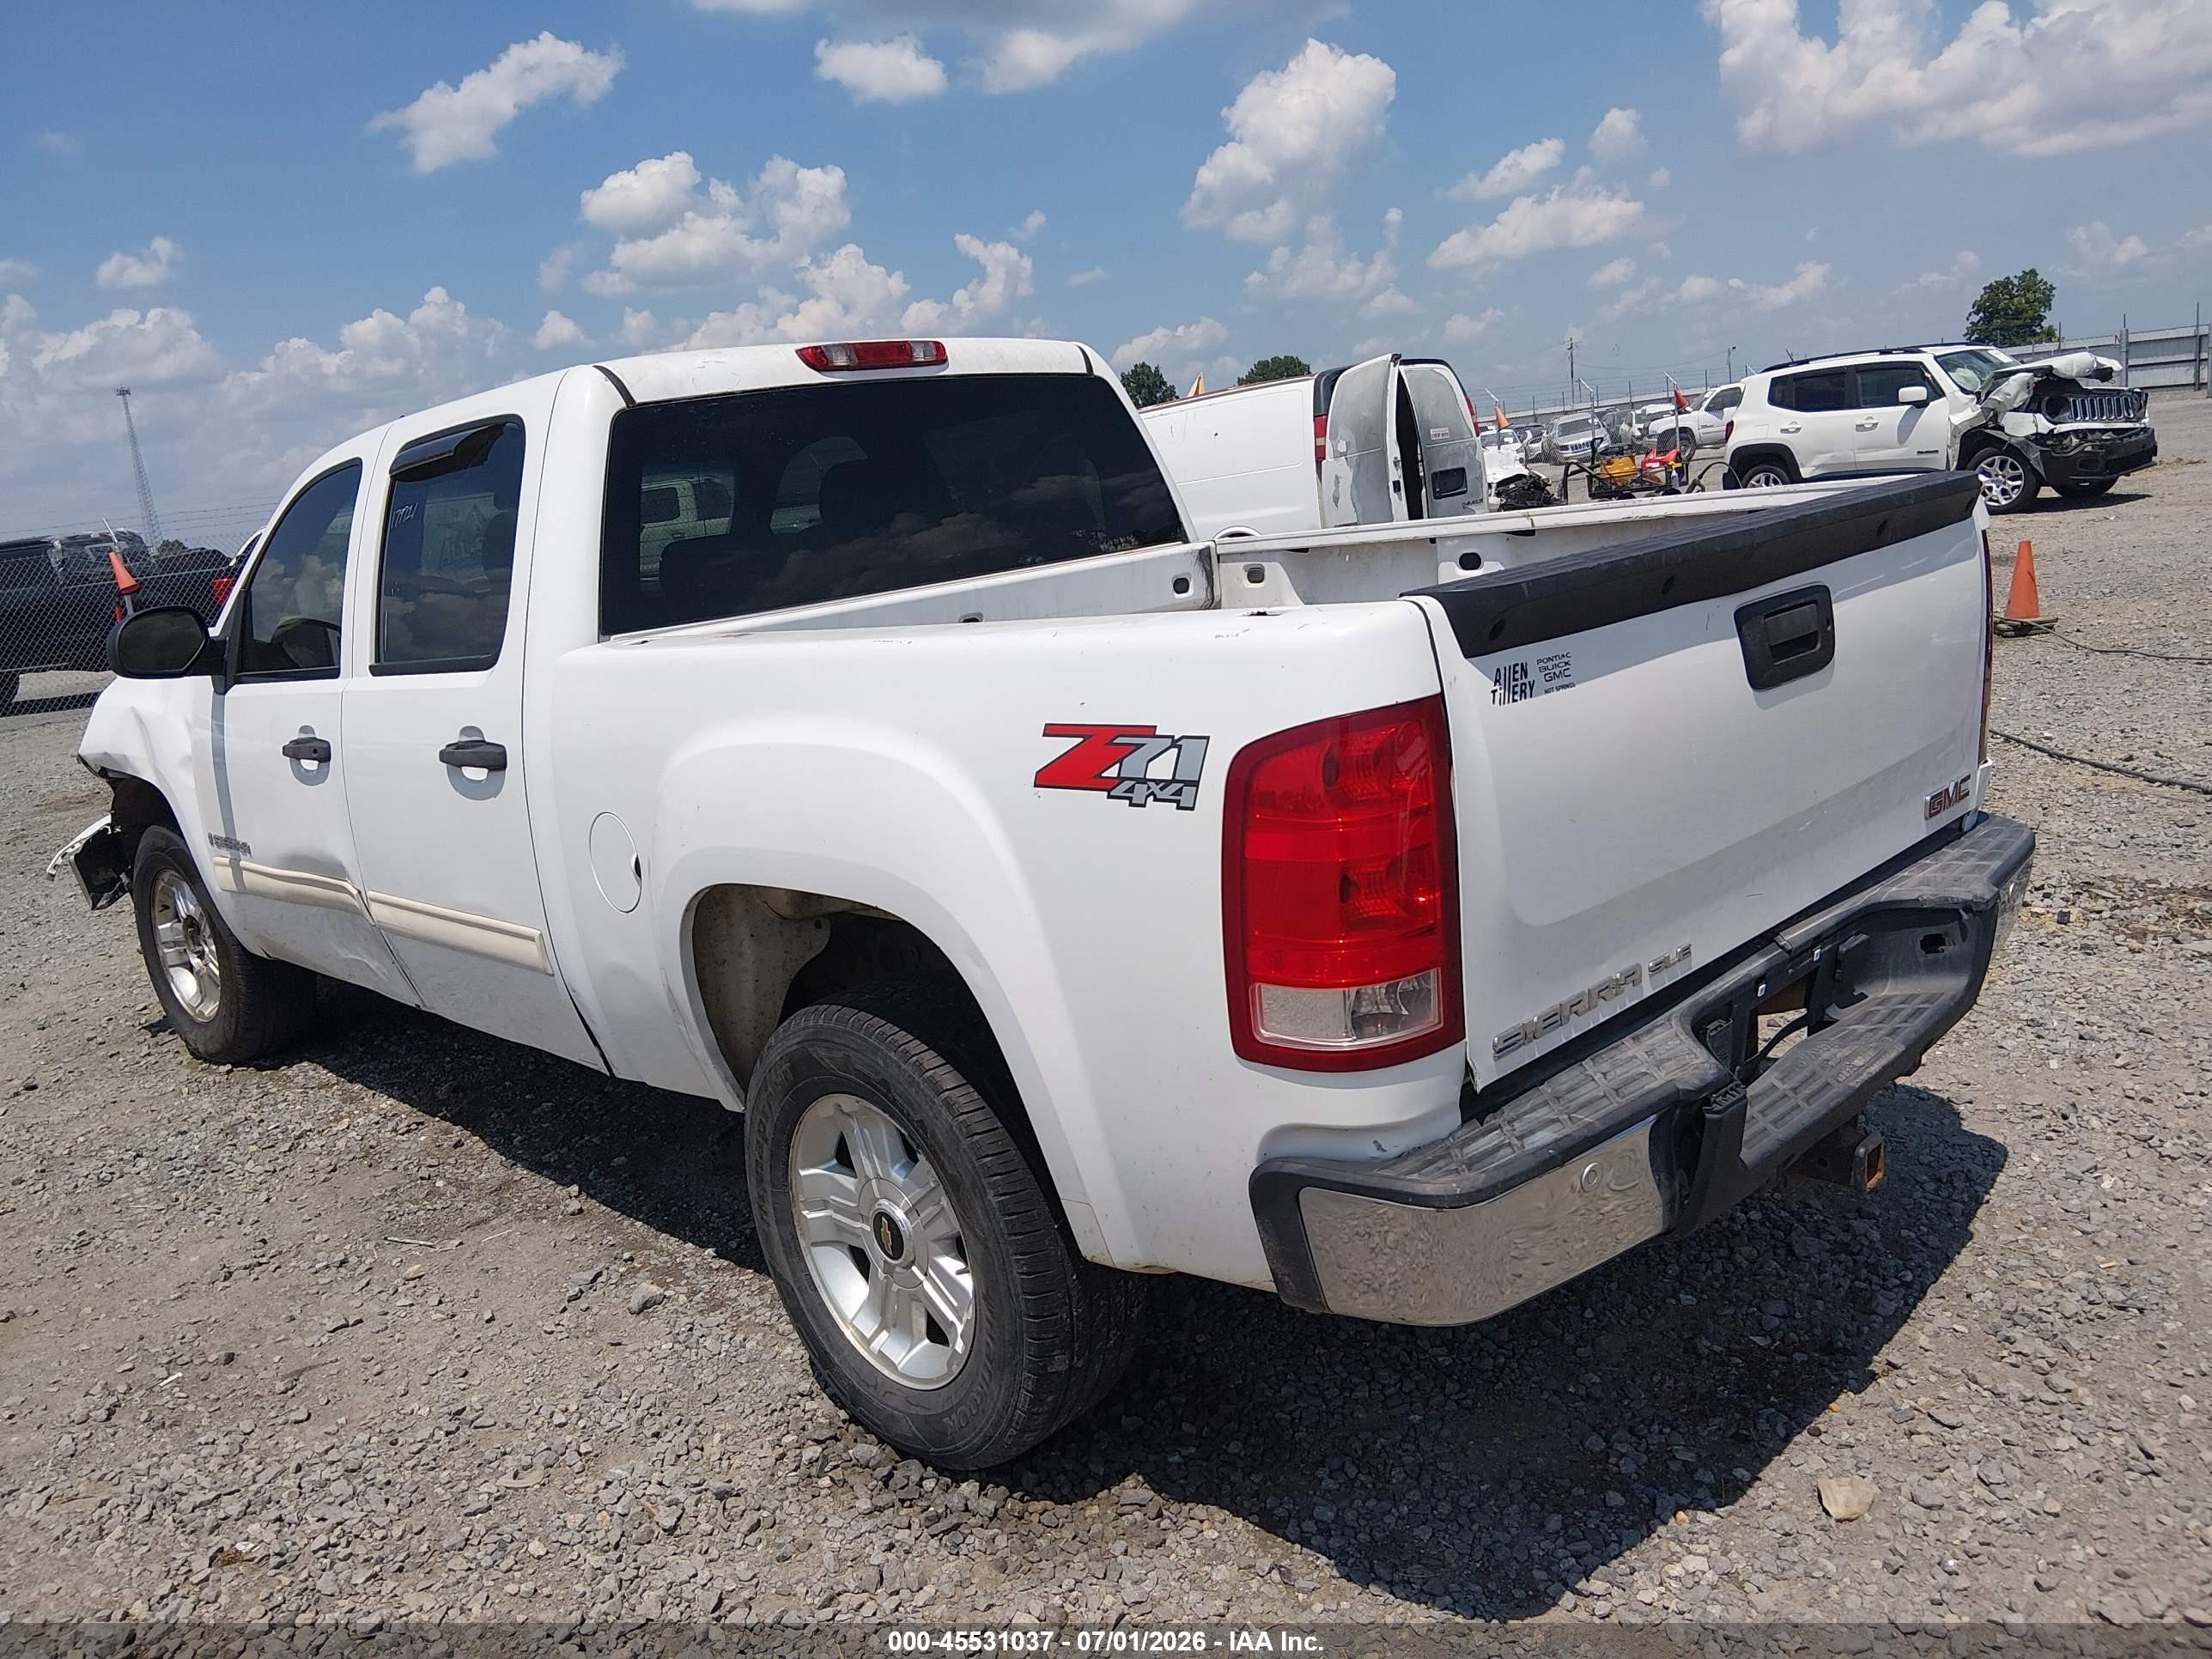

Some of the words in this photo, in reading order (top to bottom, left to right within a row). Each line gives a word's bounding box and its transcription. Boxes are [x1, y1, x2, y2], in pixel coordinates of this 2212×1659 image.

[1536, 652, 1572, 665] PONTIAC
[1539, 659, 1571, 673] BUICK
[1543, 667, 1571, 683] GMC
[1033, 722, 1211, 793] Z71
[1924, 774, 1972, 820] GMC
[1492, 962, 1643, 1061] SIERRA
[1648, 944, 1692, 975] SLE
